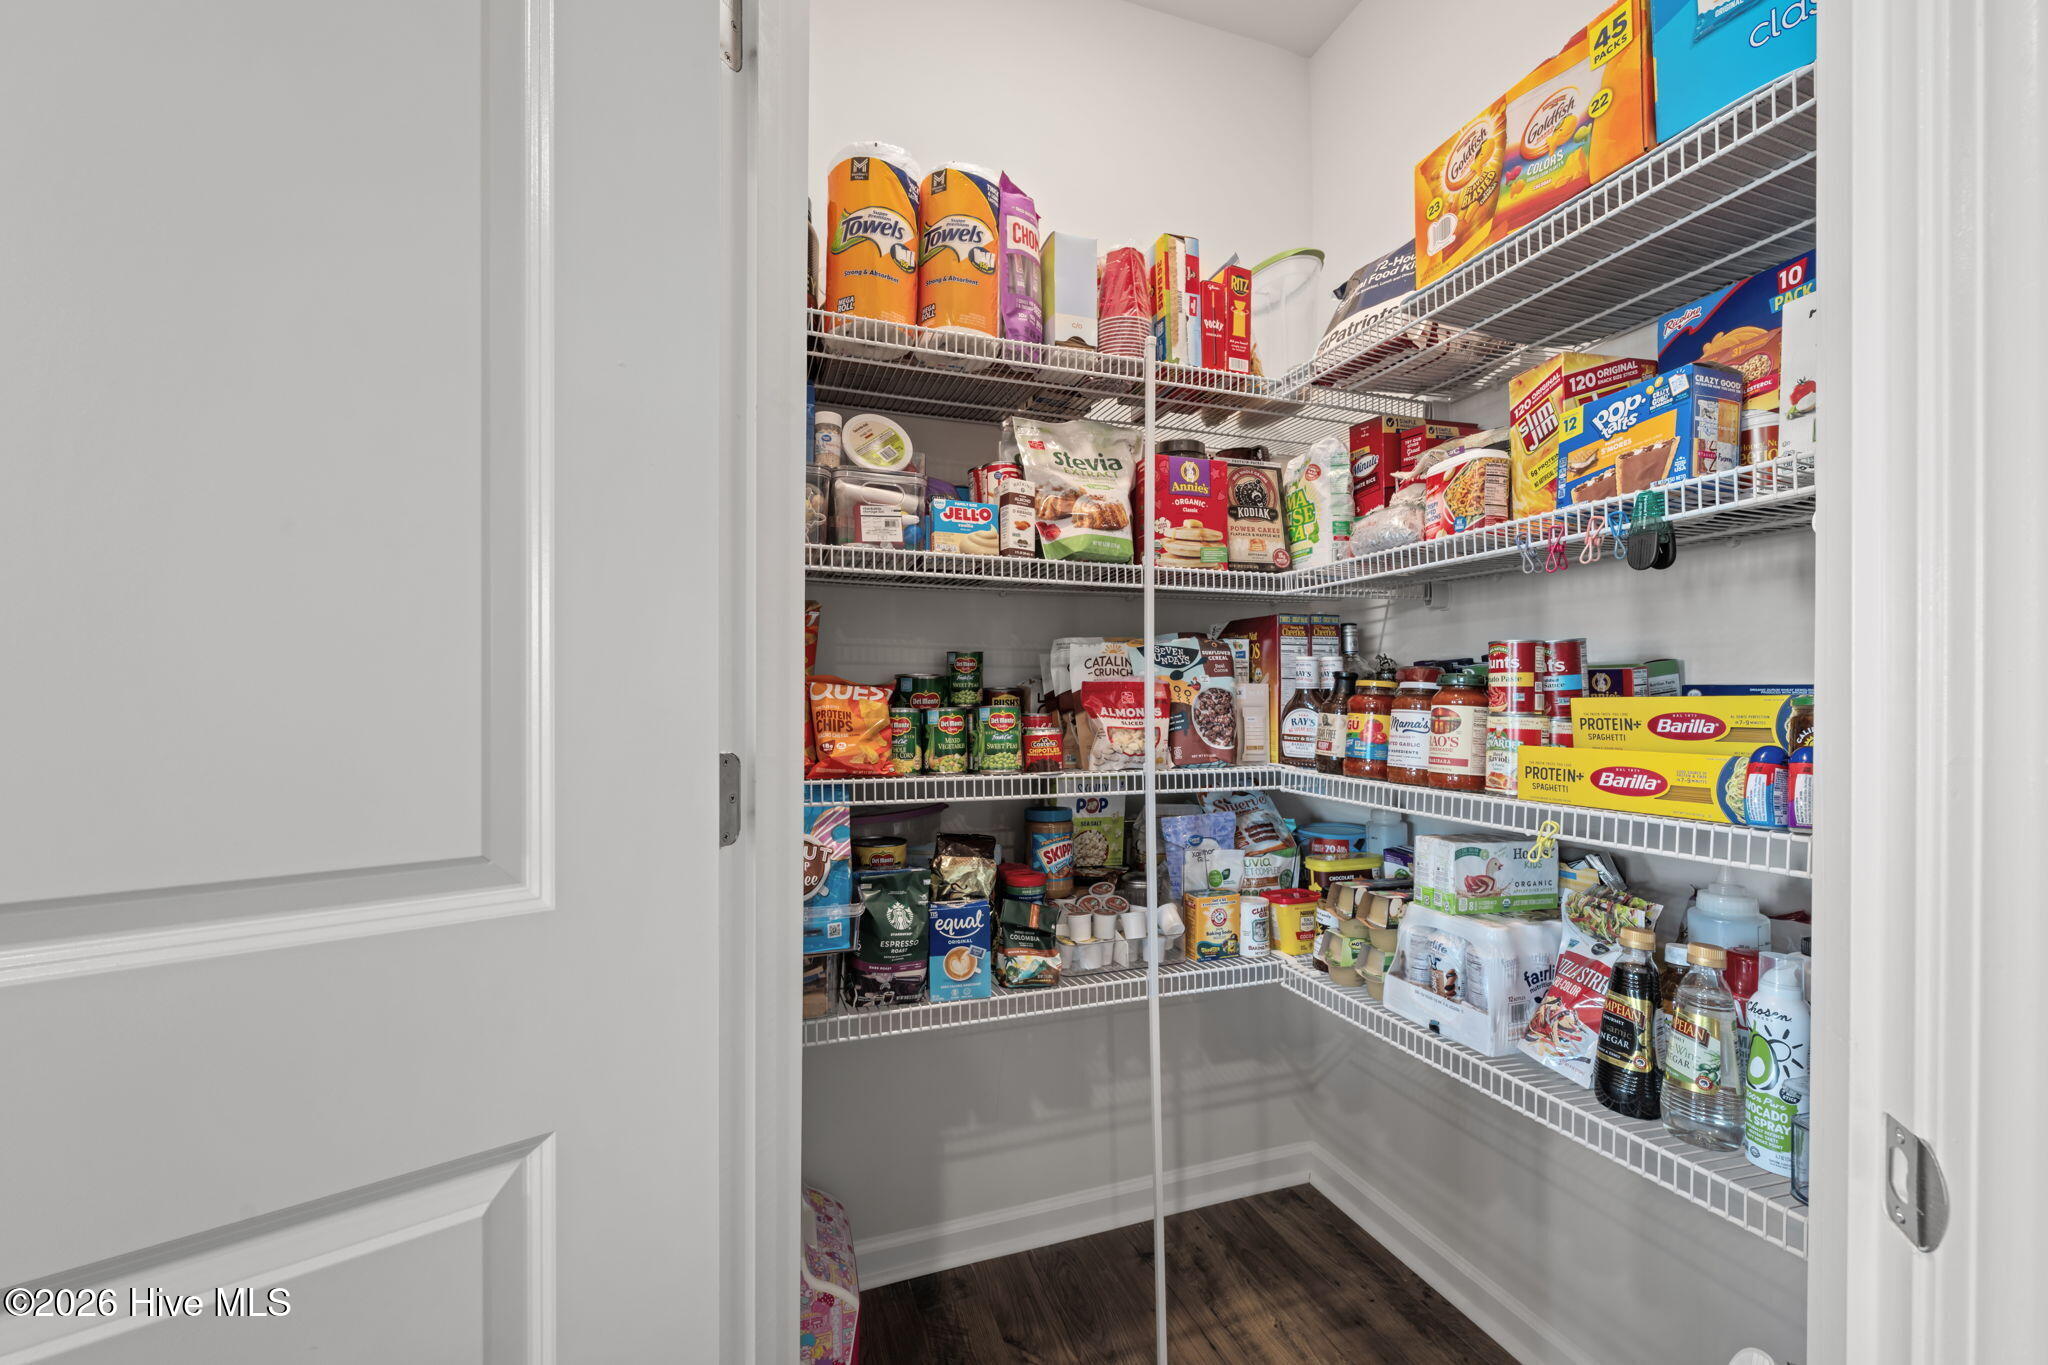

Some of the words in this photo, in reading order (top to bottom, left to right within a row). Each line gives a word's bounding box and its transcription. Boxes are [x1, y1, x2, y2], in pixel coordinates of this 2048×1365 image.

[1593, 11, 1628, 50] 45
[1594, 33, 1628, 64] PACKS
[1591, 93, 1609, 114] 22
[1527, 96, 1575, 144] Goldfish
[1451, 128, 1487, 180] Goldfish
[1526, 150, 1565, 176] COLORS
[1461, 170, 1496, 211] BLASTED
[1428, 201, 1441, 217] 23
[841, 215, 905, 243] Towels
[923, 225, 984, 254] Towels
[844, 269, 862, 277] Strong
[868, 269, 899, 284] Absorbent
[925, 278, 942, 286] Strong
[948, 275, 980, 286] Absorbent
[1231, 274, 1250, 292] RITZ
[1368, 266, 1400, 284] Food
[1779, 265, 1803, 290] 10
[1774, 282, 1813, 311] PACK
[1663, 306, 1703, 338] Ricolino
[1597, 361, 1639, 378] ORIGINAL
[1598, 377, 1613, 385] SNACK
[1623, 370, 1639, 378] STICKS
[1569, 372, 1597, 393] 120
[1695, 374, 1719, 386] CRAZY
[1720, 378, 1741, 390] GOOD
[1513, 399, 1532, 419] 120
[1531, 372, 1561, 400] ORIGINAL
[1563, 417, 1577, 433] 12
[1601, 412, 1639, 439] tarts
[1053, 451, 1123, 471] Stevia
[1353, 454, 1379, 476] Minute
[1064, 467, 1118, 478] EXTRACT
[1530, 469, 1538, 477] 6g
[1171, 482, 1209, 494] Annie's
[1175, 498, 1206, 508] ORGANIC
[1238, 507, 1271, 520] KODIAK
[1282, 628, 1306, 637] Cheerios
[1313, 628, 1337, 637] Cheerios
[1154, 651, 1191, 665] UNDAYS
[1155, 645, 1184, 656] SEVEN
[1489, 657, 1520, 670] unts
[816, 710, 852, 721] PROTEIN
[999, 716, 1014, 724] Monte
[1100, 706, 1163, 718] ALMONS
[816, 720, 854, 733] CHIPS
[1291, 717, 1316, 727] RAY'S
[1391, 716, 1430, 733] Mama's
[1580, 718, 1642, 731] PROTEIN+
[1656, 719, 1715, 734] Barilla
[1325, 730, 1337, 740] FREE
[1588, 733, 1626, 741] SPAGHETTI
[1524, 766, 1584, 782] PROTEIN+
[1599, 774, 1658, 790] Barilla
[1532, 783, 1569, 793] SPAGHETTI
[1076, 797, 1109, 814] POP
[1213, 796, 1267, 813] Swerve
[1325, 845, 1336, 853] 70
[1244, 858, 1271, 867] uvia
[1524, 861, 1543, 869] KIDS
[1515, 879, 1553, 888] ORGANIC
[1469, 901, 1474, 911] 8
[934, 909, 985, 935] equal
[880, 940, 919, 948] ESPRESSO
[1010, 934, 1040, 942] COLOMBIA
[1604, 1000, 1643, 1023] MPEIAN
[1746, 1000, 1792, 1022] Chosen
[1674, 1016, 1706, 1042] PEIAN
[1600, 1031, 1629, 1049] NEGAR
[1745, 1099, 1789, 1124] VOCADO
[1763, 1097, 1787, 1111] Pure
[1754, 1115, 1791, 1135] SPRAY
